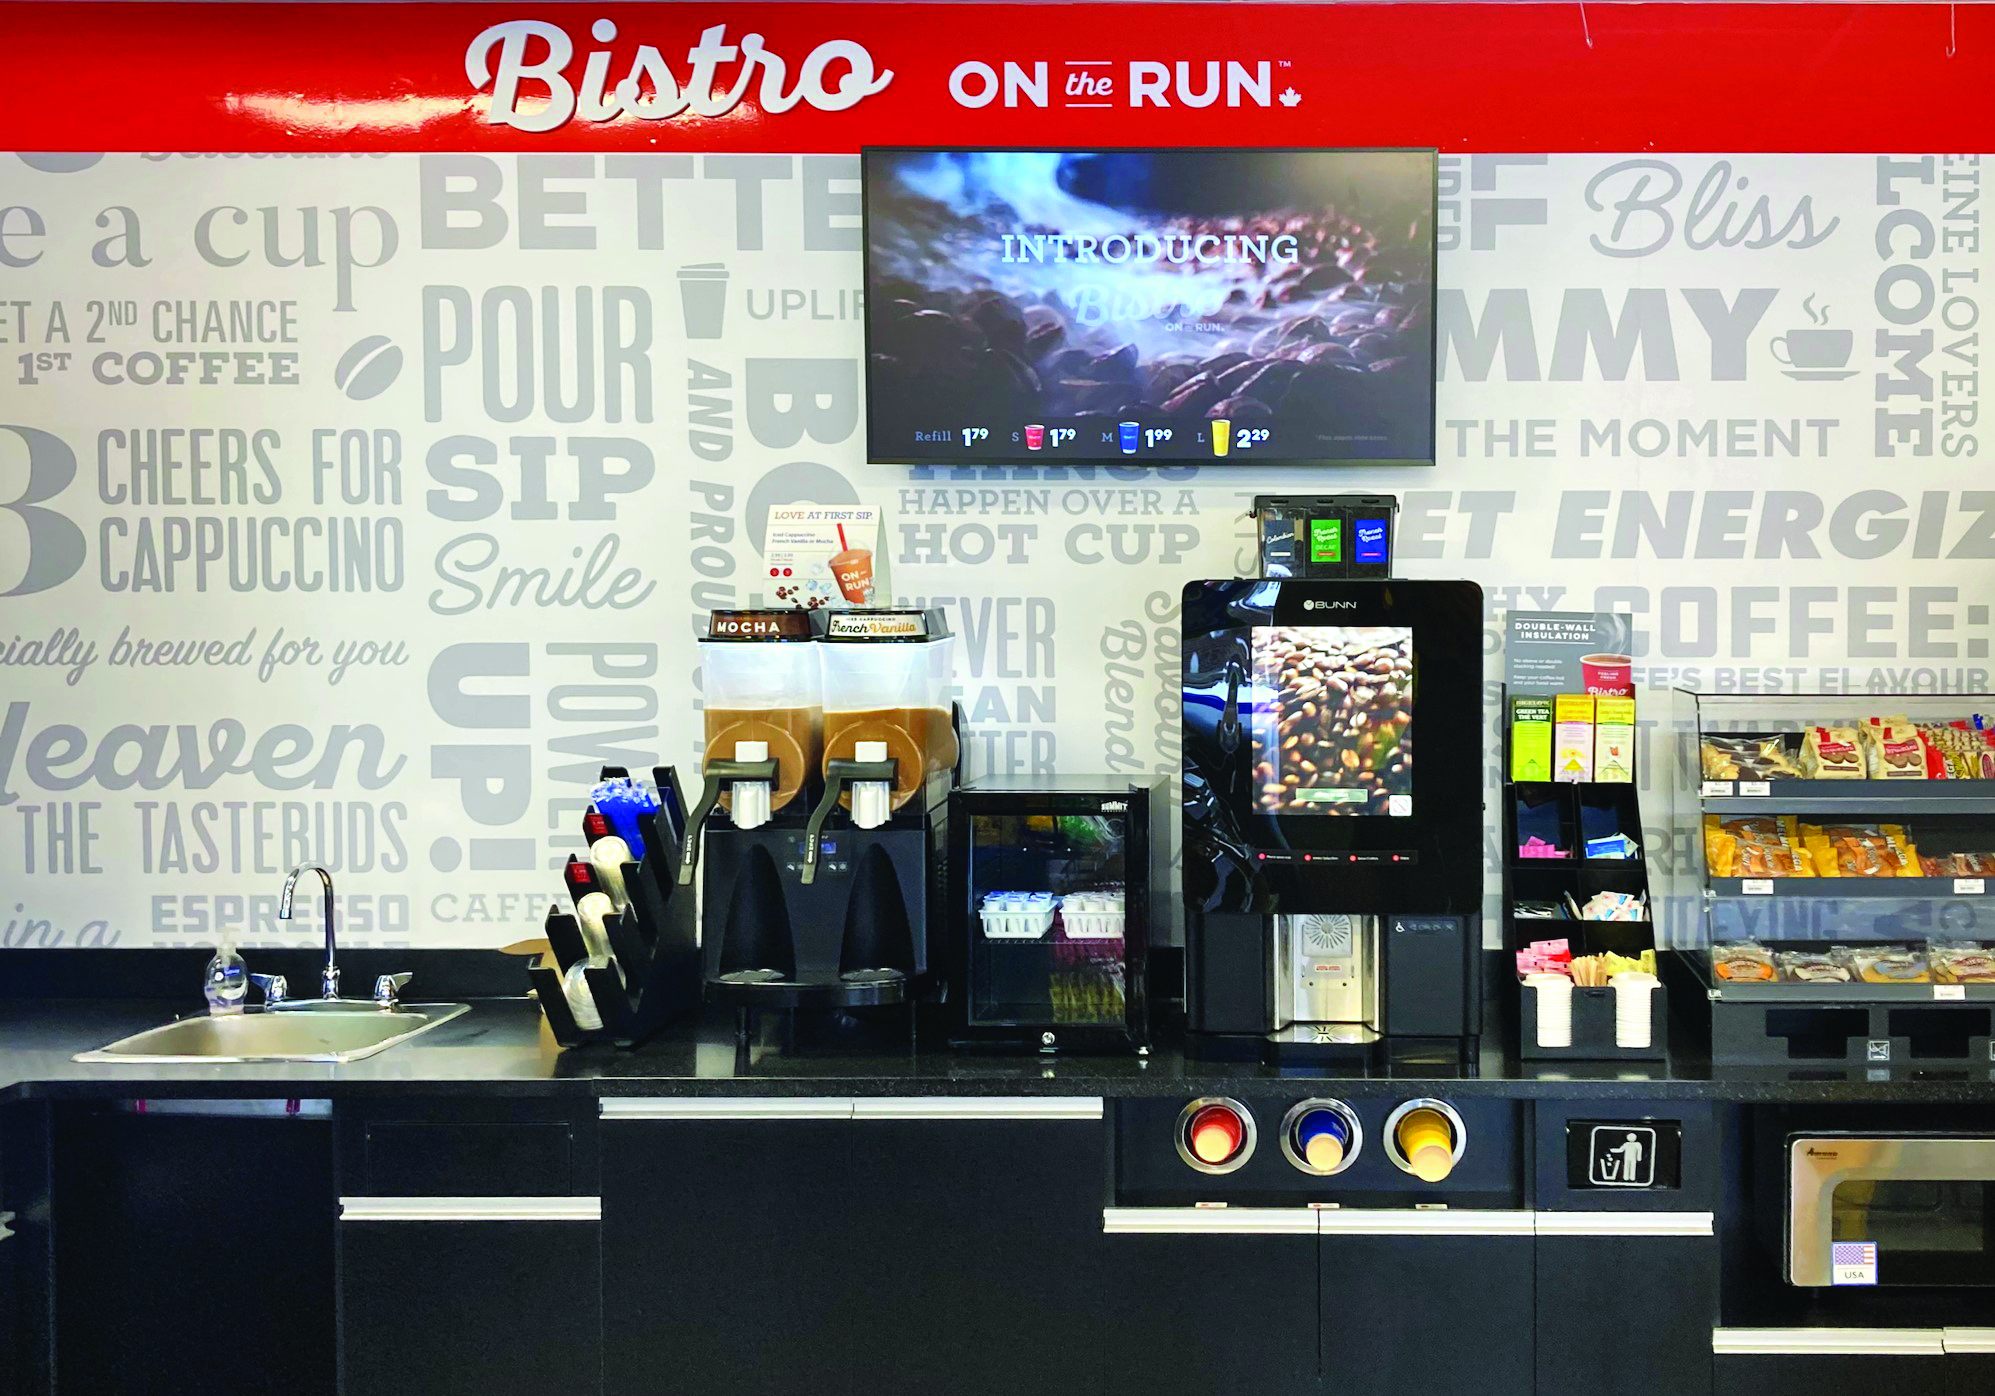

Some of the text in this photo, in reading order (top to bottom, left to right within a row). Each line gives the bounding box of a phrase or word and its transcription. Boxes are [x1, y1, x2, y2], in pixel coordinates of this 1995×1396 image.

[465, 18, 893, 133] Bistro
[948, 61, 1048, 108] ON
[1065, 72, 1113, 96] the
[1129, 61, 1271, 107] RUN
[1584, 160, 1840, 258] Bliss
[91, 206, 153, 268] a
[194, 206, 399, 312] cup
[1001, 235, 1299, 264] INTRODUCING
[45, 301, 71, 343] A
[86, 300, 137, 343] 2ND
[153, 300, 298, 343] CHANCE
[1165, 323, 1183, 332] ON
[18, 351, 299, 385] 1ST COFFEE
[423, 285, 653, 423] POUR
[1941, 268, 1980, 457] LOVERS
[688, 358, 733, 463] AND
[915, 430, 951, 442] Refill
[1012, 432, 1019, 443] S
[1102, 432, 1113, 443] M
[1197, 432, 1205, 443] L
[1446, 419, 1840, 458] THE MOMENT
[99, 429, 402, 504] CHEERS FOR
[425, 435, 656, 521] SIP
[774, 511, 805, 520] LOVE
[807, 511, 822, 520] AT
[824, 511, 854, 520] FIRST
[899, 490, 1200, 515] HAPPEN OVER A
[101, 517, 404, 592] CAPPUCCINO
[899, 523, 1038, 564] HOT
[1064, 523, 1200, 564] CUP
[428, 533, 656, 615] Smile
[841, 572, 859, 582] ON
[845, 578, 870, 591] RUN
[1315, 601, 1357, 609] BUNN
[717, 622, 780, 633] MOCHA
[831, 620, 916, 633] French Vanilla
[1515, 622, 1596, 632] DOUBLE-WALL
[1521, 631, 1589, 640] INSULATION
[108, 625, 252, 668] brewed
[258, 629, 321, 683] for
[328, 638, 409, 686] you
[1100, 619, 1147, 772] Blend
[1587, 686, 1629, 696] Bistro
[427, 642, 536, 872] UP!
[17, 801, 408, 874] THE TASTEBUDS
[152, 895, 409, 932] ESPRESSO
